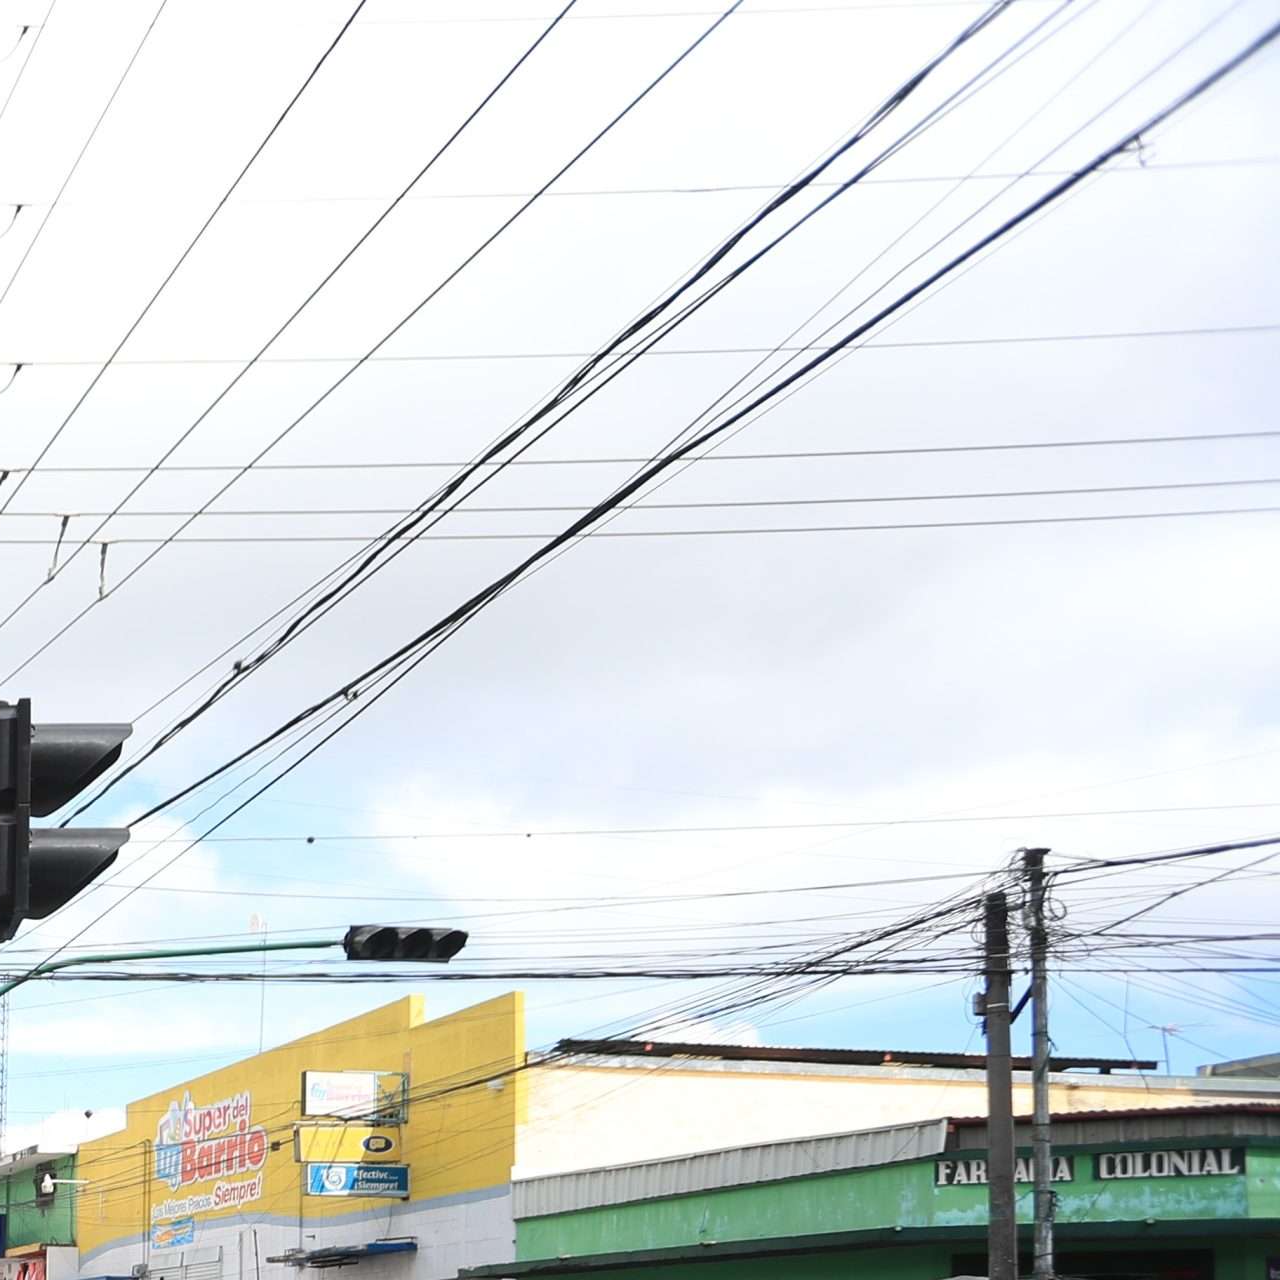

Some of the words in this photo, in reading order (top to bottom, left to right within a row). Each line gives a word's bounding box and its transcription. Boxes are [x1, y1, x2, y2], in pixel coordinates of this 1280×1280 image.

[183, 1103, 231, 1142] Super
[233, 1095, 249, 1120] del
[181, 1119, 265, 1184] Barrio
[1099, 1149, 1240, 1179] COLONIAL
[214, 1175, 262, 1207] Siempre!
